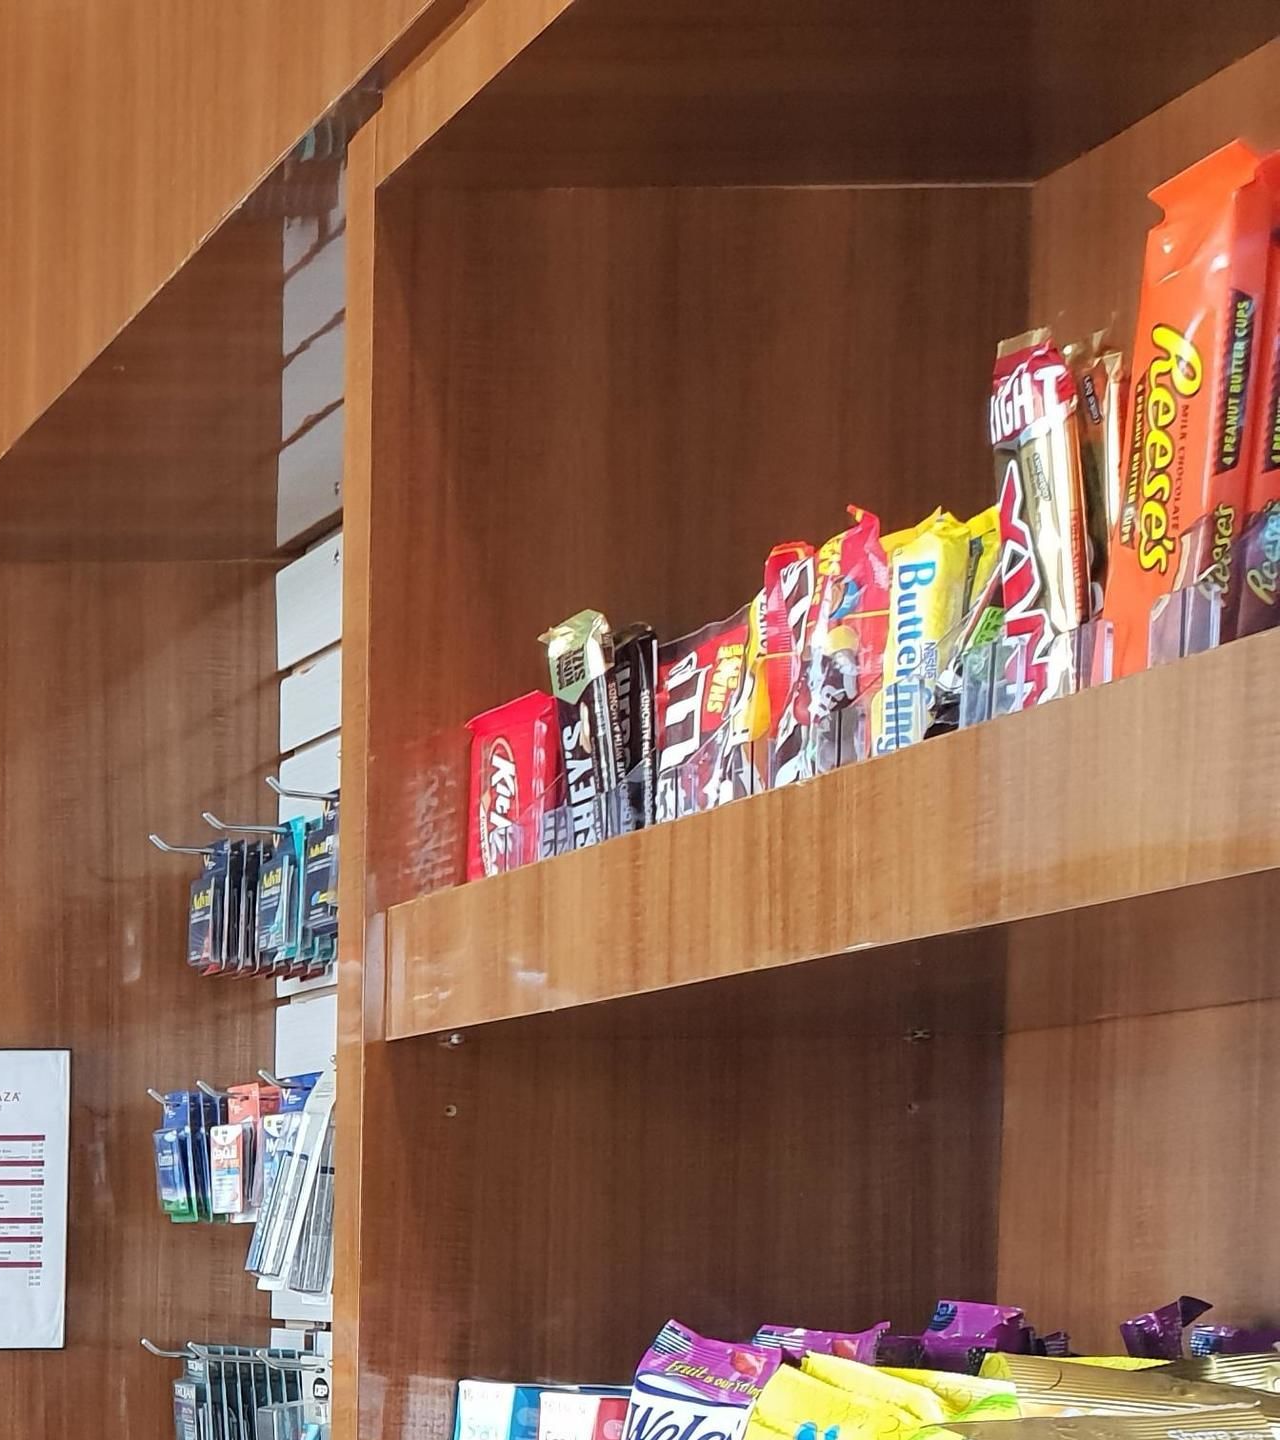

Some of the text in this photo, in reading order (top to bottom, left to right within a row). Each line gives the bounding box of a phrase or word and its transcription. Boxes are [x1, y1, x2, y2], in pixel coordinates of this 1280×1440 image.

[1235, 300, 1251, 338] CUPS
[1229, 341, 1246, 393] BUTTER
[1141, 323, 1204, 574] Reese's
[1223, 398, 1241, 453] PEANUT
[665, 1360, 708, 1382] Fruit
